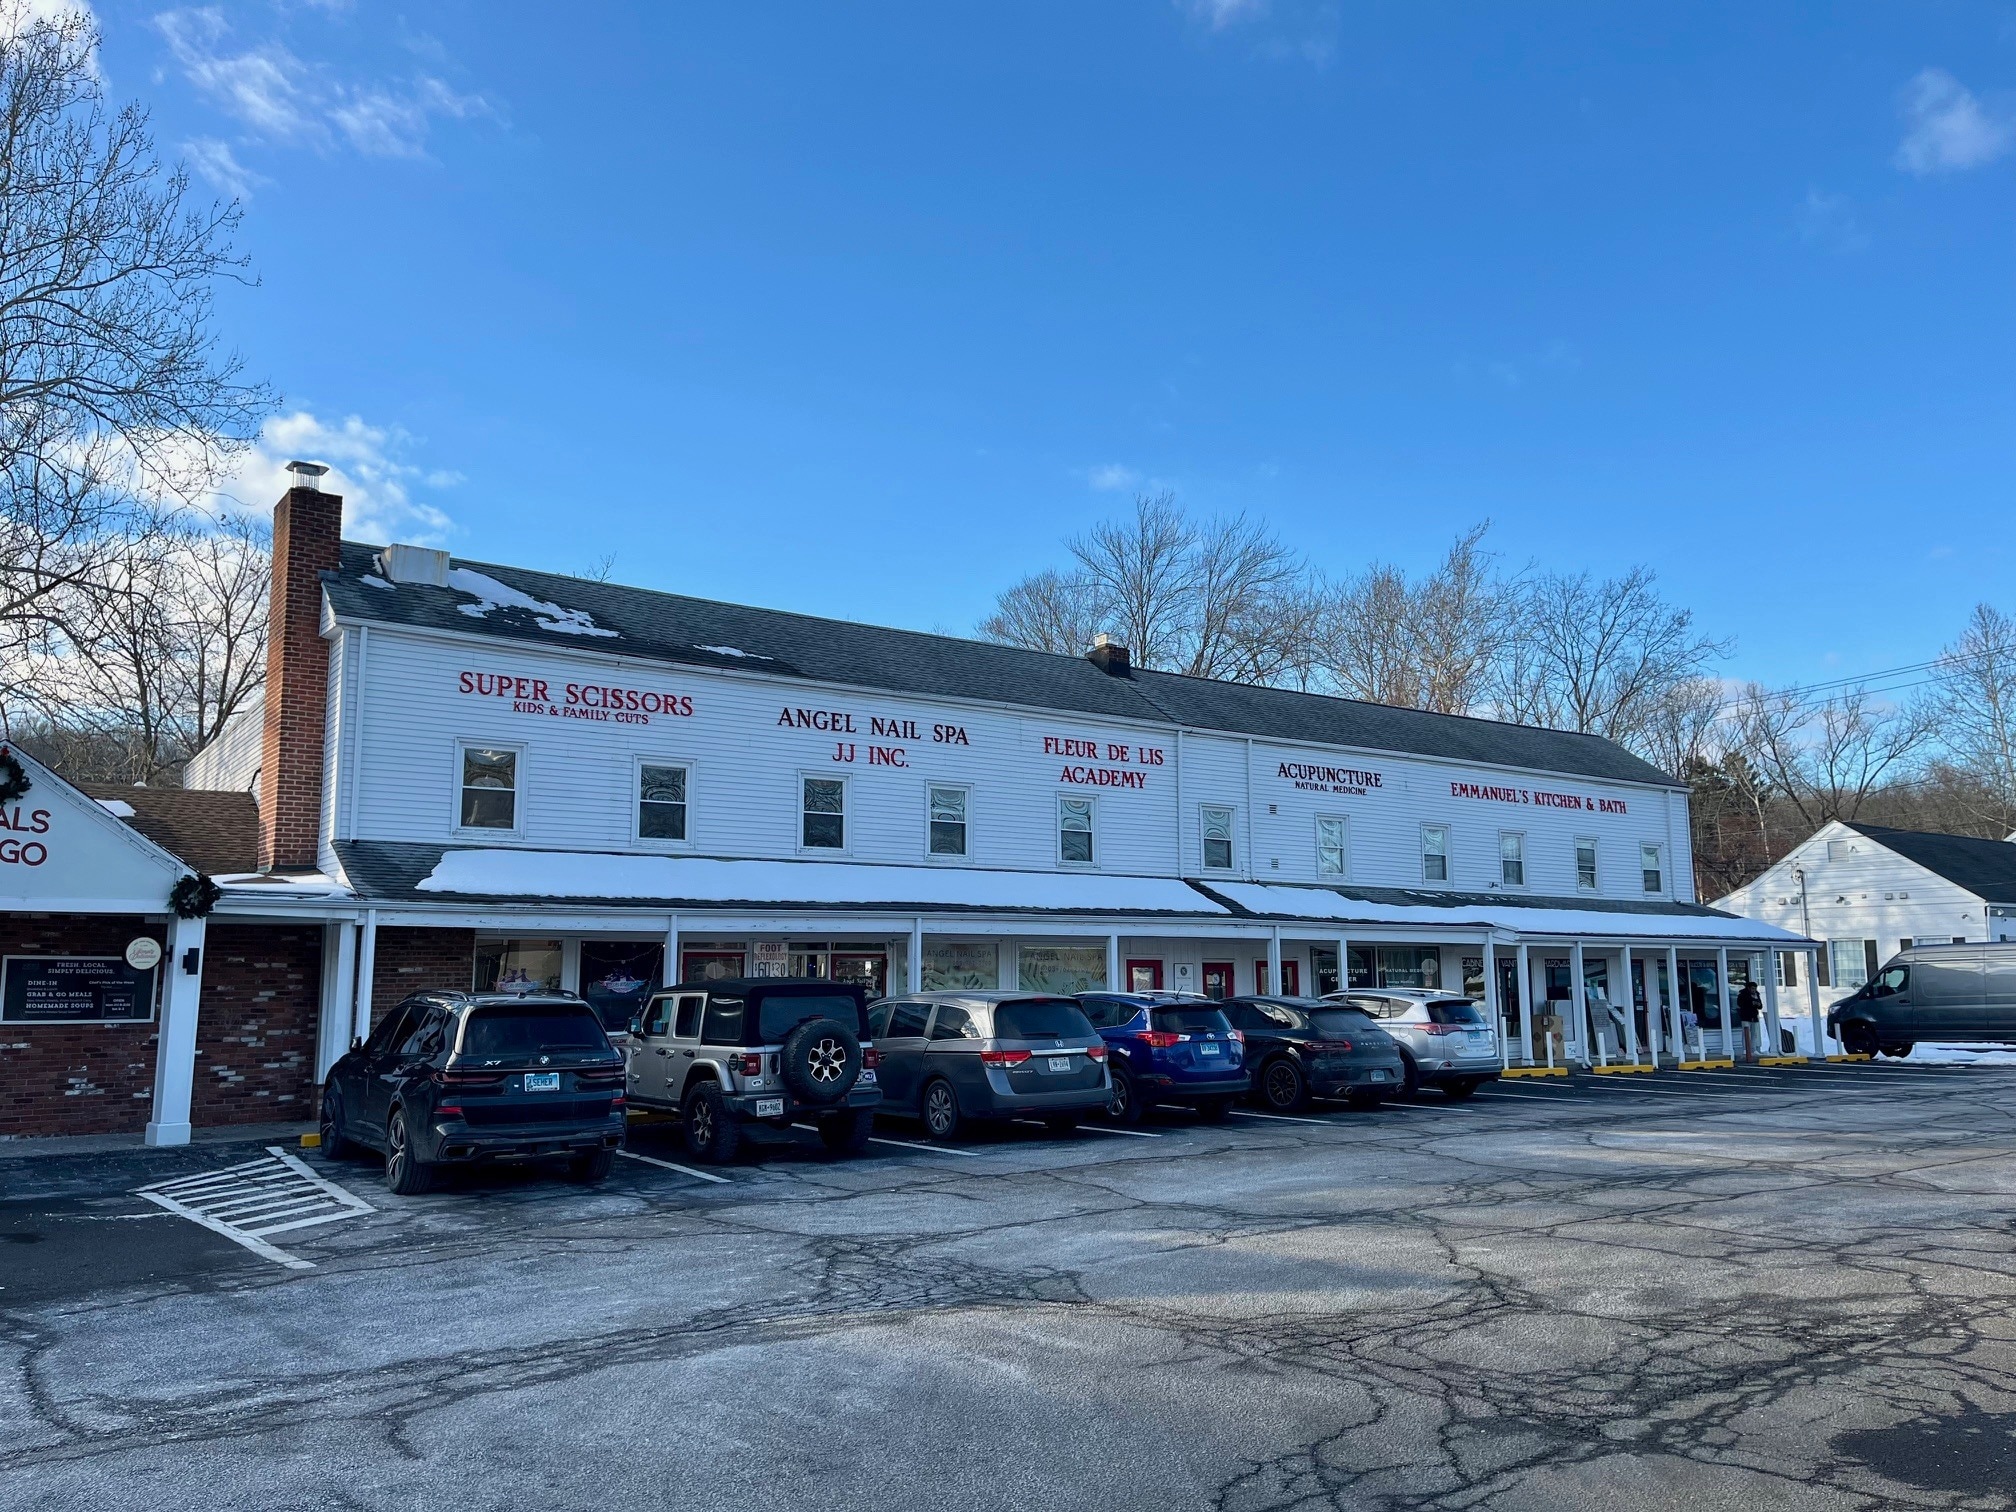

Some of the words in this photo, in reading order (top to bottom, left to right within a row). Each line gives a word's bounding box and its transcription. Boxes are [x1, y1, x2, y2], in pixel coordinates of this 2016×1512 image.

[459, 671, 550, 701] SUPER
[565, 683, 694, 717] SCISSORS
[513, 701, 544, 715] KIDS
[549, 705, 559, 716] &
[563, 706, 610, 721] FAMILY
[615, 712, 649, 725] CUTS
[777, 707, 857, 733] ANGEL
[870, 717, 921, 740] NAIL
[933, 724, 969, 745] SPA
[832, 742, 856, 762] JJ
[868, 746, 910, 768] INC.
[1043, 737, 1098, 759] FLEUR
[1108, 744, 1130, 762] DE
[1139, 747, 1164, 766] LIS
[1060, 765, 1147, 789] ACADEMY
[1277, 762, 1383, 788] ACUPUNCTURE
[1295, 781, 1329, 792] NATURAL
[1332, 785, 1367, 796] MEDICINE
[1450, 782, 1529, 804] EMMANUEL'S
[1534, 791, 1582, 810] KITCHEN
[1586, 797, 1595, 811] &
[1598, 798, 1627, 814] BATH
[0, 838, 48, 867] GO
[760, 944, 782, 953] FOOT
[926, 949, 954, 958] ANGEL
[956, 949, 975, 958] NAIL
[977, 949, 992, 958] SPA
[1461, 958, 1483, 967] CABINE
[1544, 958, 1571, 968] HARDWAR
